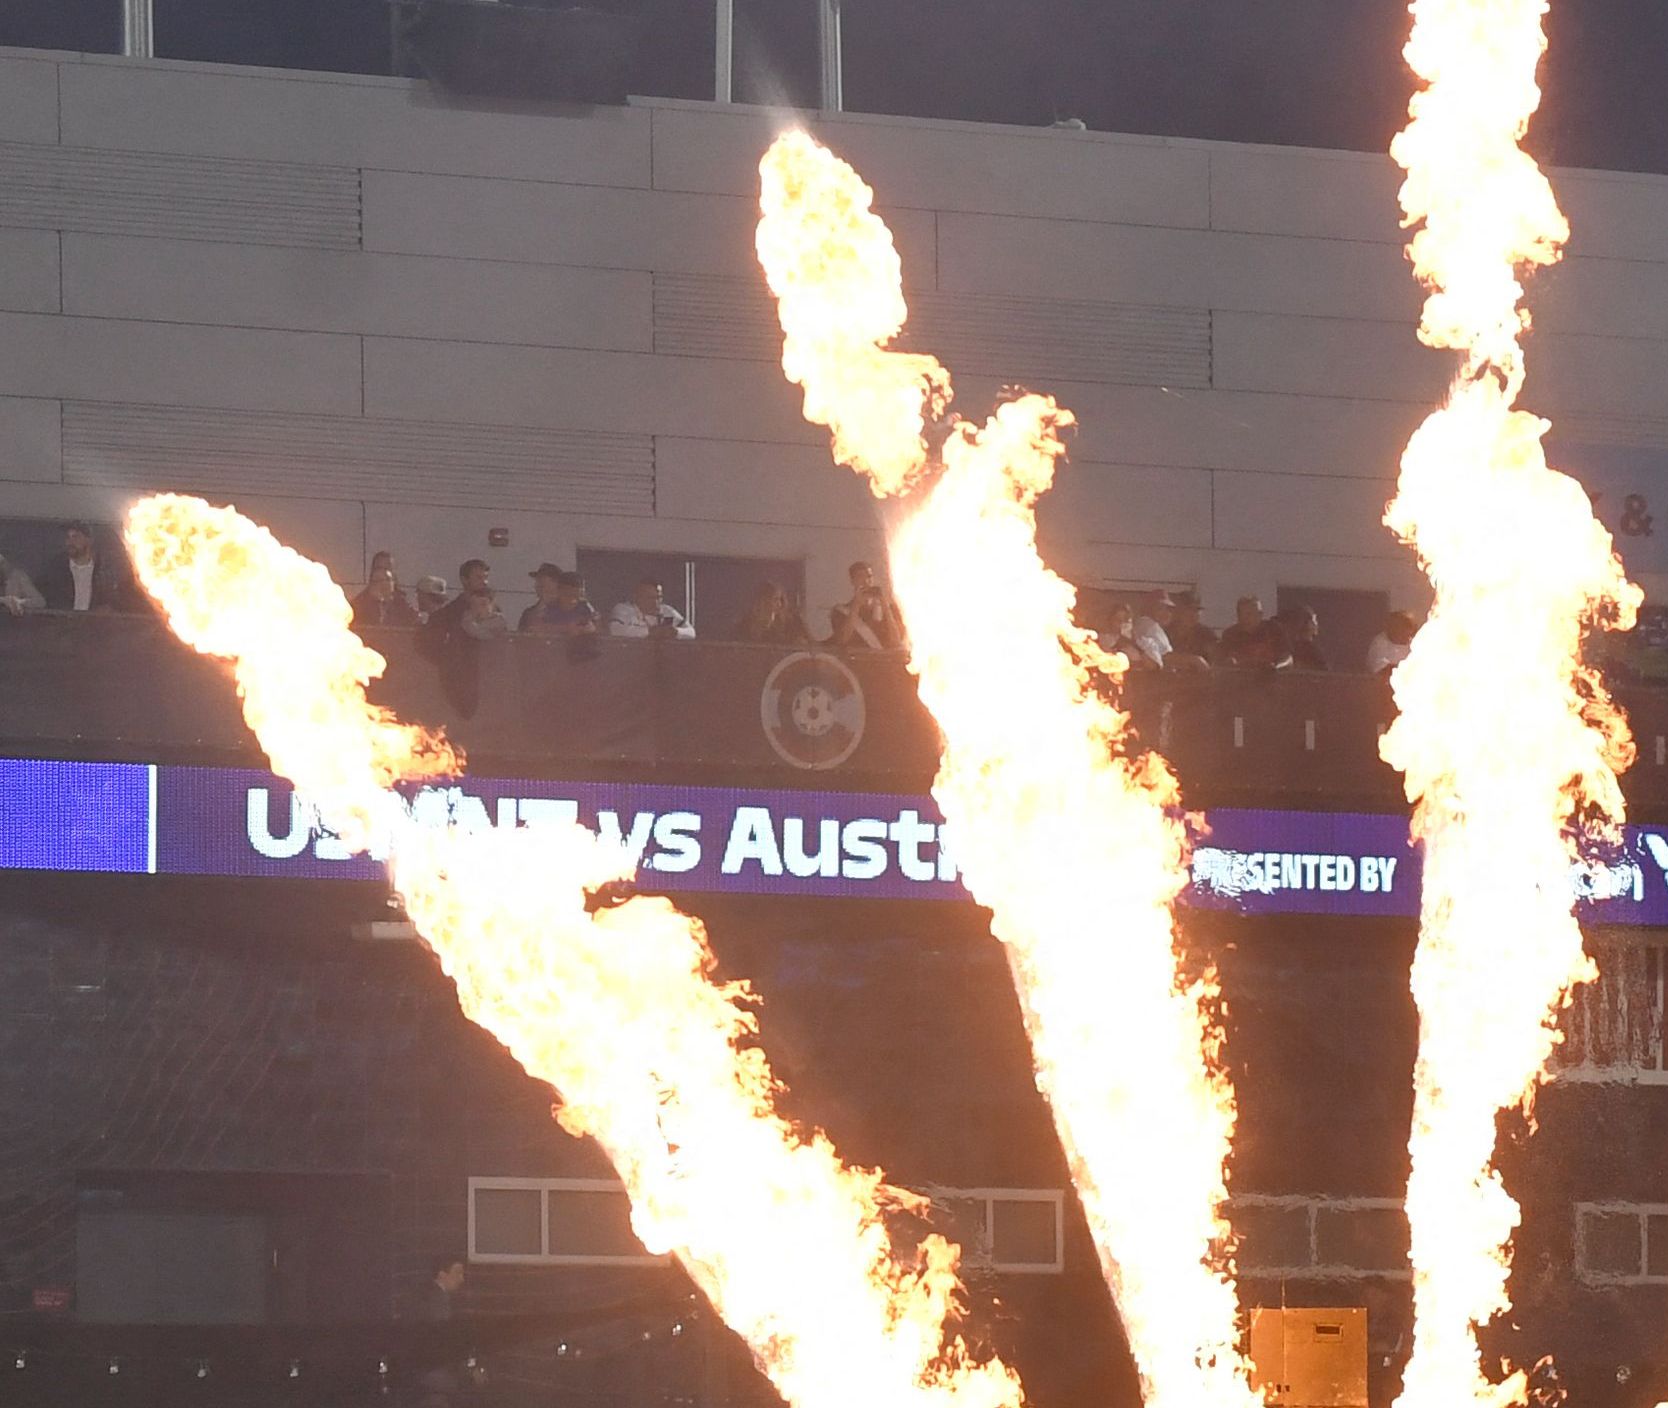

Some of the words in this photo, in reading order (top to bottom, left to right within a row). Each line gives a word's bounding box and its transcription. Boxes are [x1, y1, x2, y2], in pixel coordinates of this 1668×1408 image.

[1620, 493, 1653, 537] &
[598, 811, 701, 873] vs
[1360, 857, 1397, 892] BY
